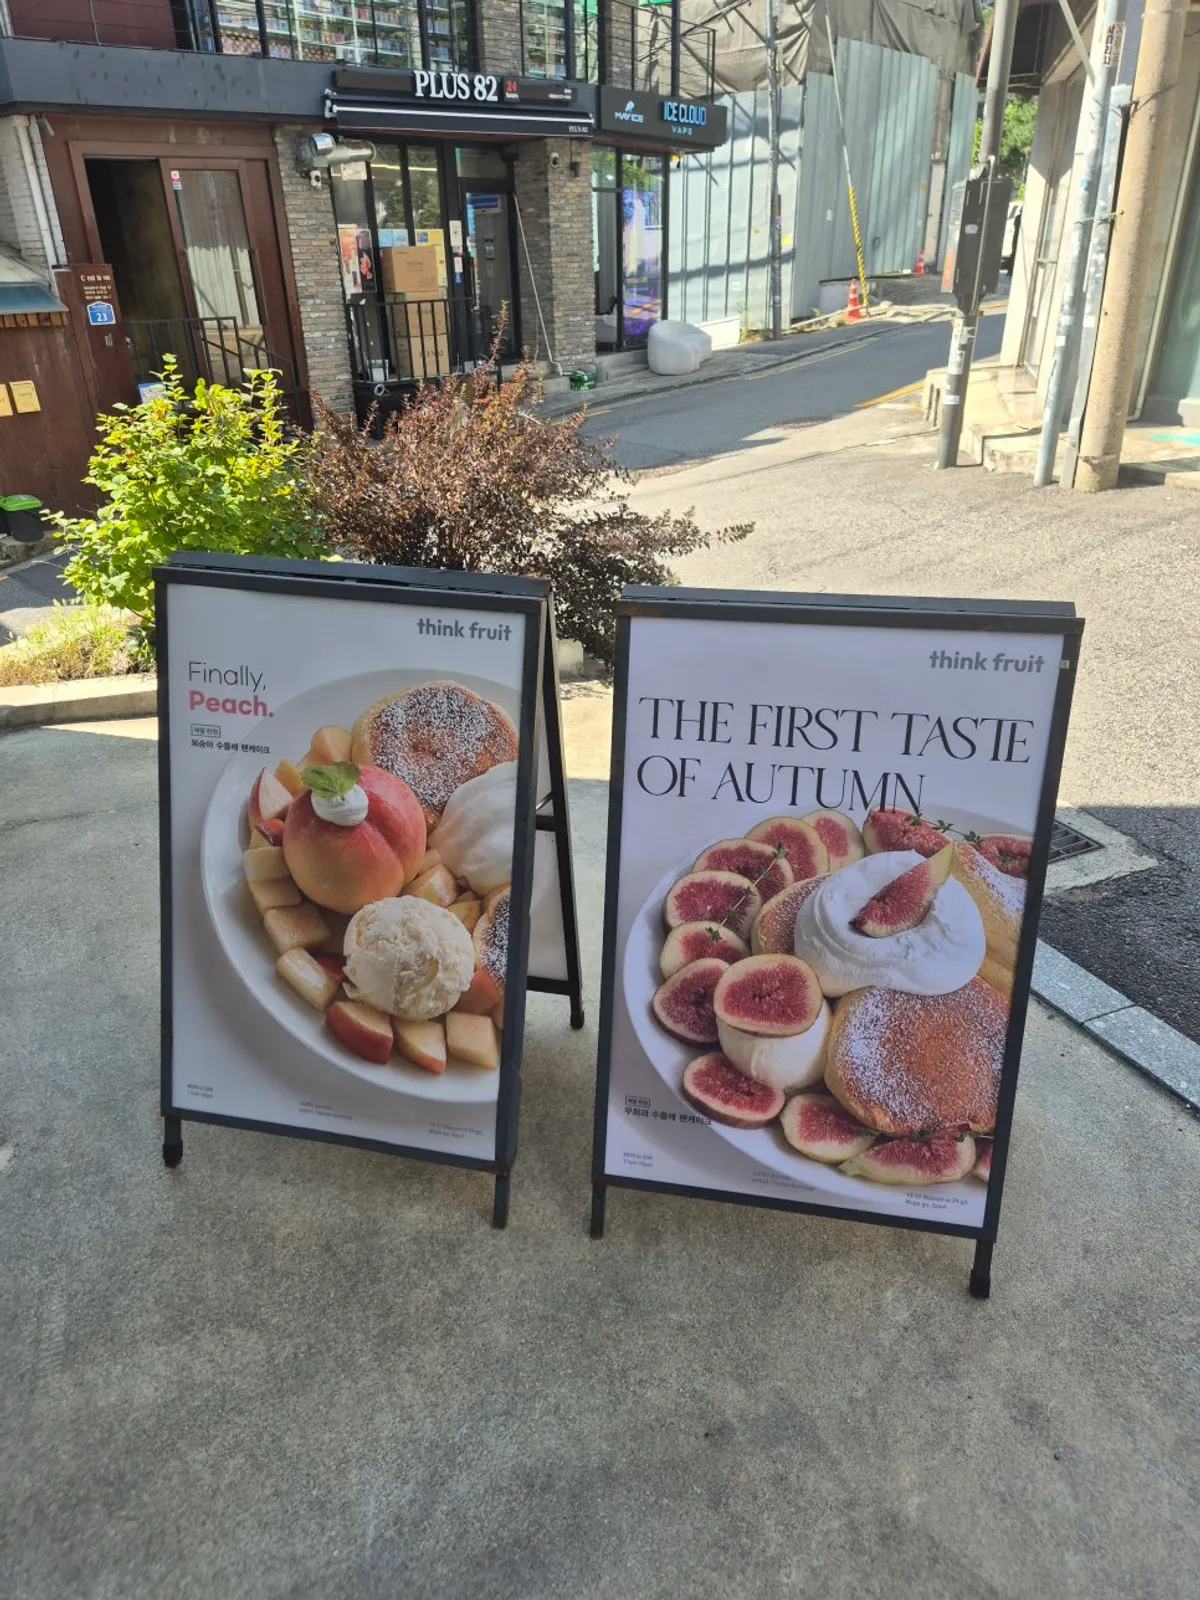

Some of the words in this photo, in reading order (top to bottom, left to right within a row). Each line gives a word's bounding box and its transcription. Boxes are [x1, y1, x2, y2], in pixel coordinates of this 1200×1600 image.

[413, 70, 470, 100] PLUS
[473, 75, 498, 101] 82
[663, 101, 678, 122] ICE
[679, 104, 707, 125] CLOUD
[671, 125, 693, 136] VAPE
[96, 312, 108, 322] 23
[417, 618, 465, 638] think
[469, 621, 512, 641] fruit
[929, 650, 987, 672] think
[992, 652, 1045, 673] fruit
[188, 660, 266, 693] Finally,
[189, 689, 274, 718] Peach.
[639, 696, 734, 744] THE
[747, 703, 878, 753] FIRST
[891, 712, 1035, 764] TASTE
[637, 755, 701, 798] OF
[711, 761, 925, 814] AUTUMN
